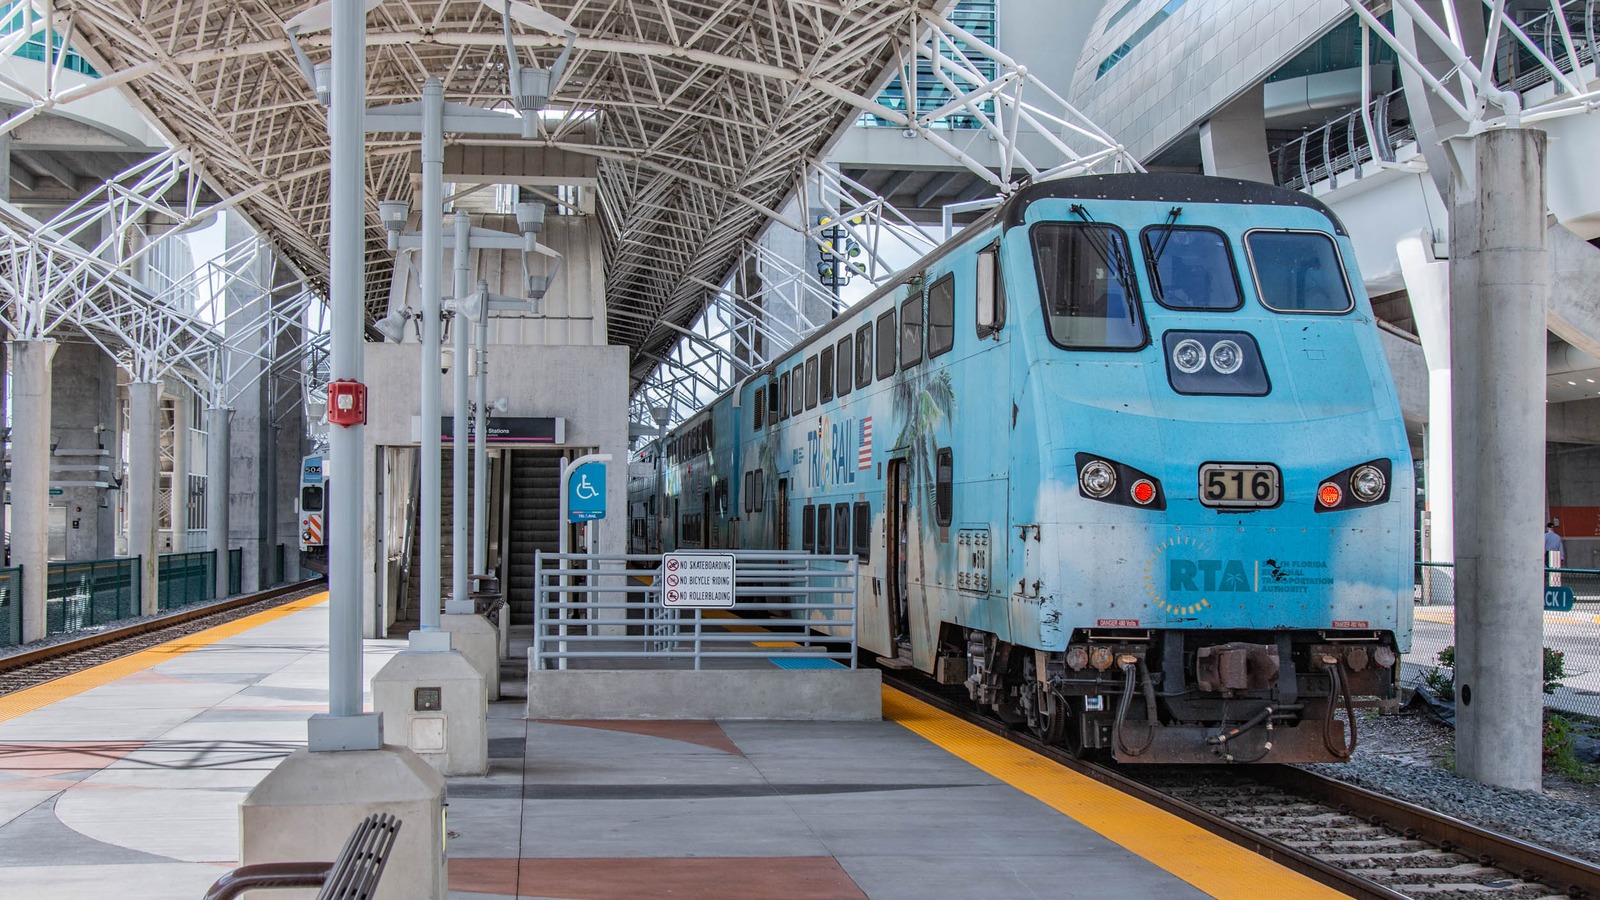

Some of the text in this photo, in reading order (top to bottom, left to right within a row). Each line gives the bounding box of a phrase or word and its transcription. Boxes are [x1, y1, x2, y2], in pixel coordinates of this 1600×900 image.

[832, 418, 855, 485] RAIL
[1207, 471, 1270, 500] 516
[679, 560, 731, 570] NO SKATEBOARDING
[1262, 560, 1327, 569] STH FLORIDA
[679, 575, 730, 586] NO BICYCLE RIDING
[1170, 559, 1250, 593] RTA
[1261, 585, 1308, 593] AUTHORITY
[679, 591, 731, 601] NO ROLLERBLADING
[1544, 591, 1559, 606] CK
